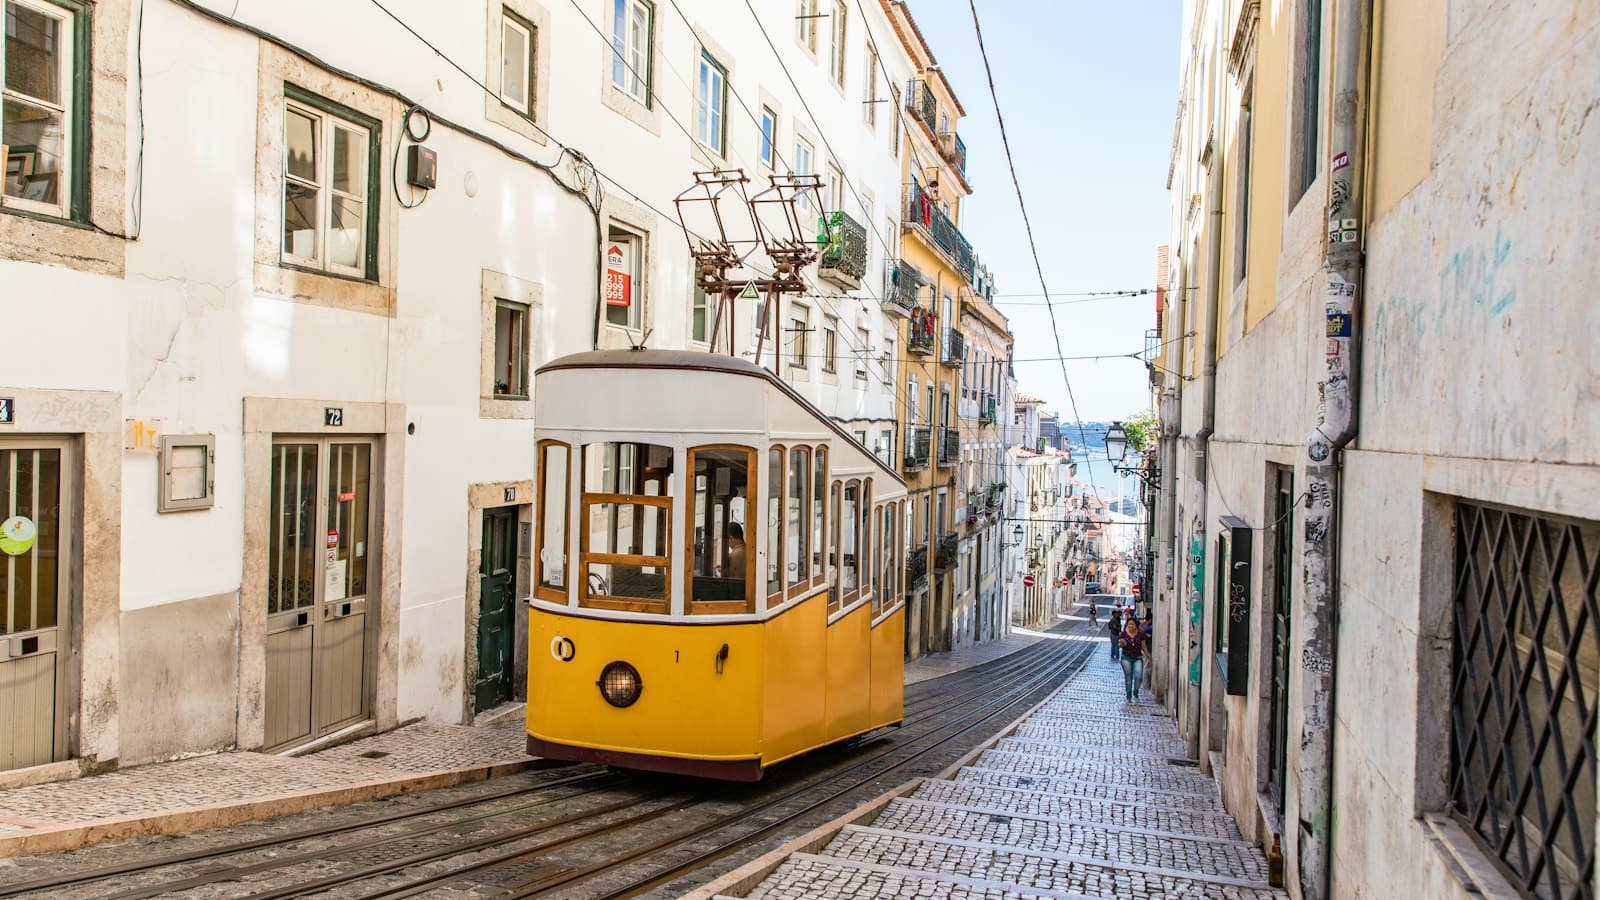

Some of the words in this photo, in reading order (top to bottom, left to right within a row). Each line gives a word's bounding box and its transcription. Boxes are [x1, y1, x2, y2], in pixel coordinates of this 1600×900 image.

[608, 274, 623, 283] 215
[608, 283, 623, 291] 999
[607, 291, 623, 299] 995
[328, 409, 341, 425] 72
[506, 488, 514, 501] 71
[675, 650, 679, 663] 1
